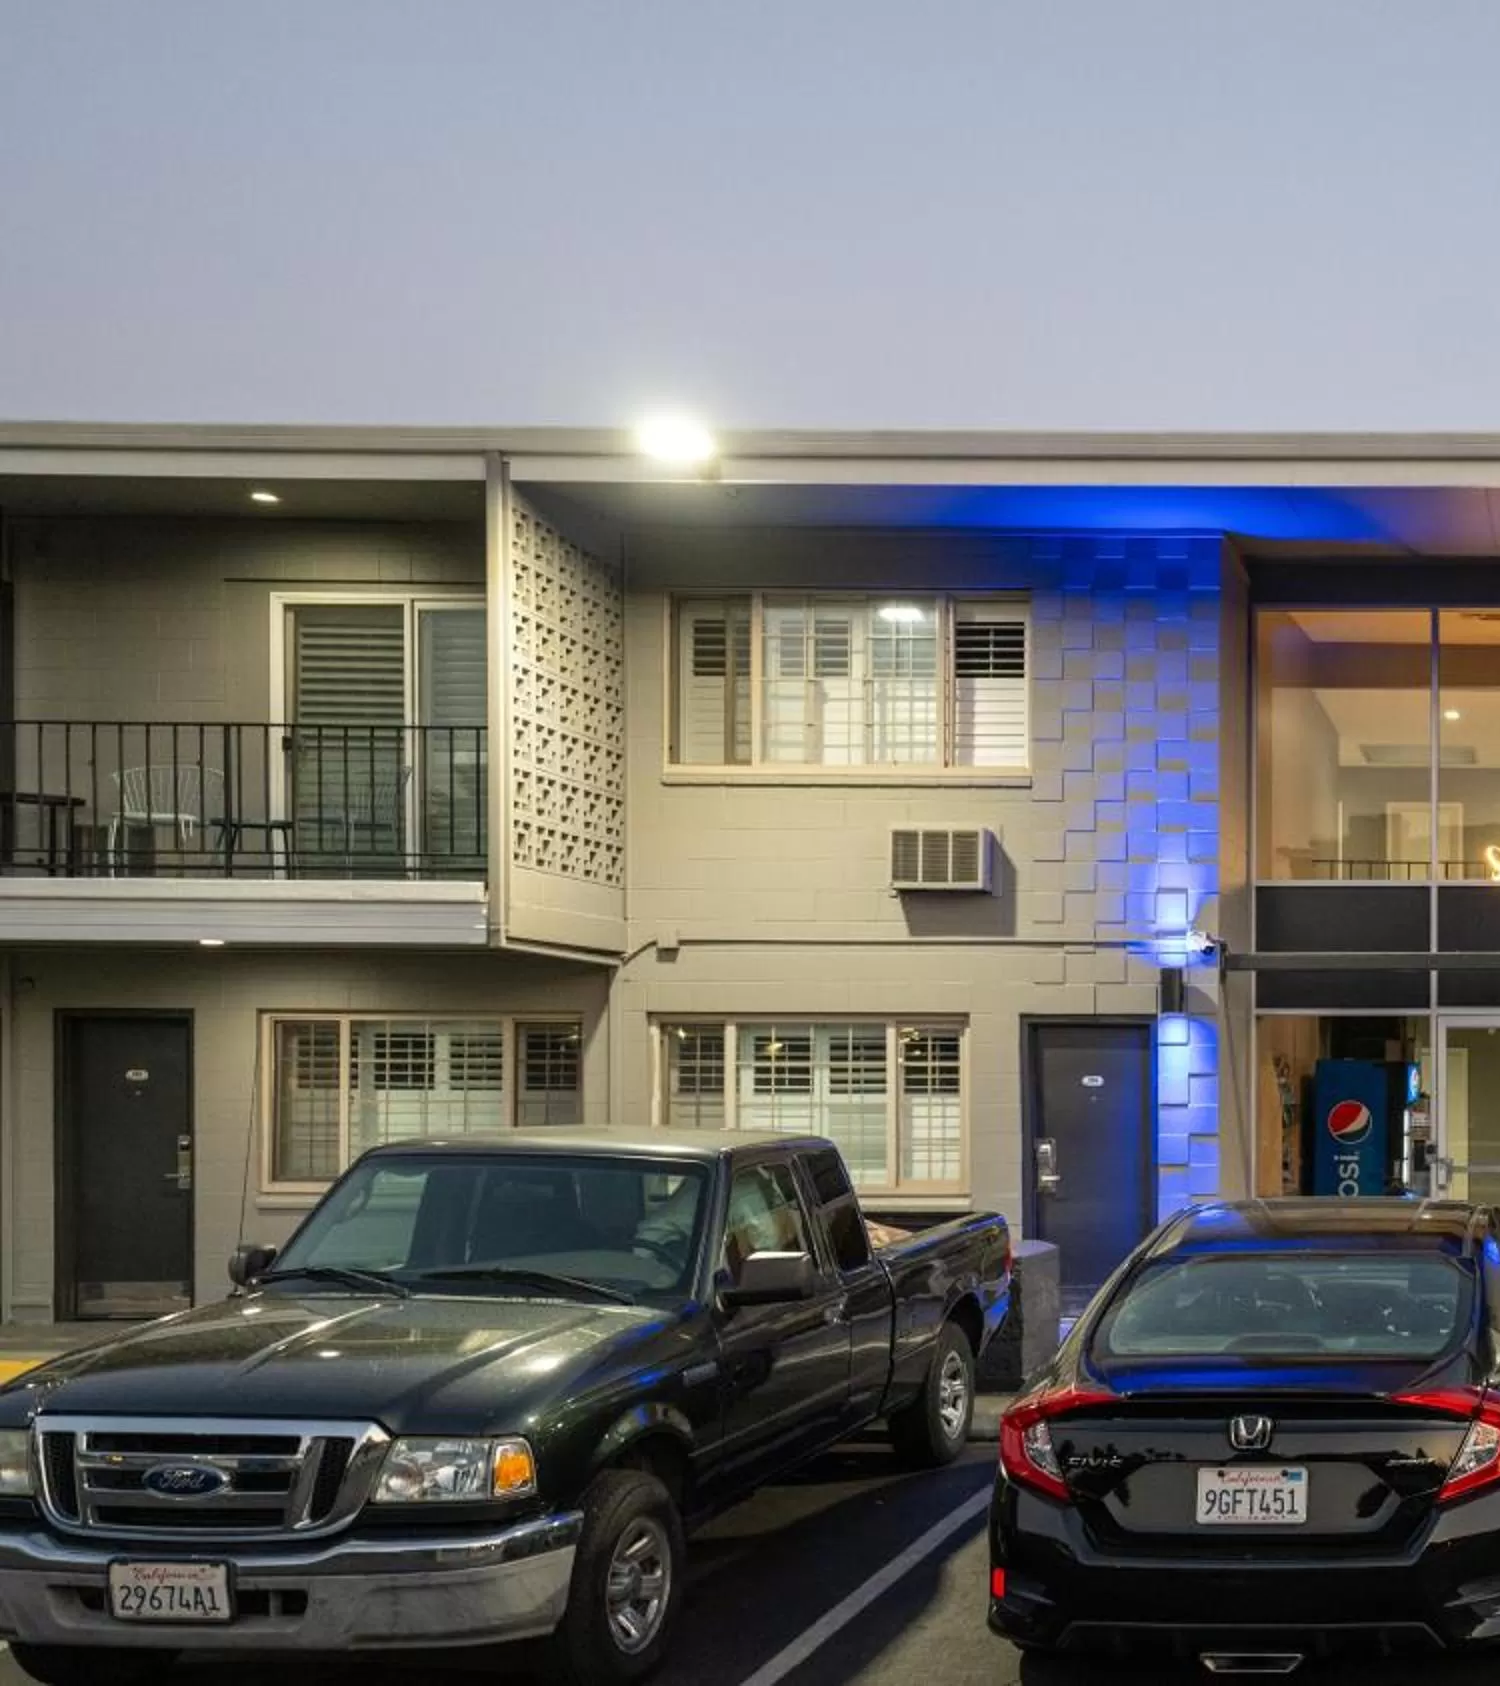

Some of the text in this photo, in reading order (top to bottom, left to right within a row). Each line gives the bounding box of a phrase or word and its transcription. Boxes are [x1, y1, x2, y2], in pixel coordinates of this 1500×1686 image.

[157, 1468, 207, 1490] Ford
[1204, 1488, 1298, 1515] 9GFT451
[119, 1585, 221, 1614] 29674A1
